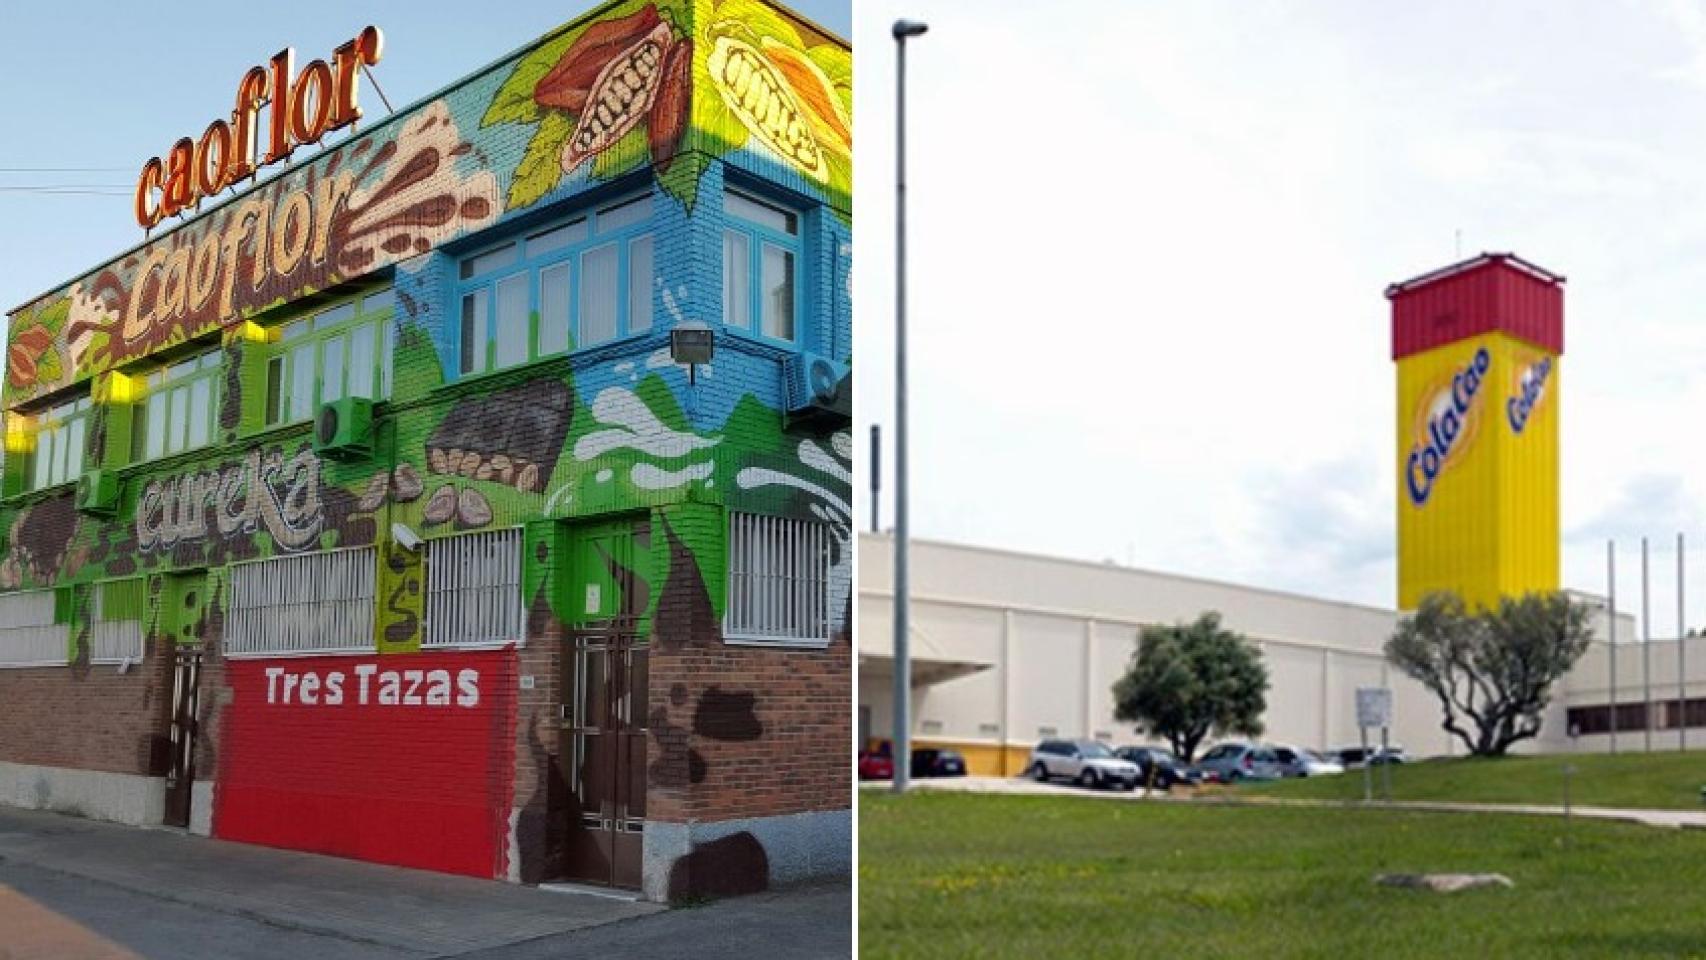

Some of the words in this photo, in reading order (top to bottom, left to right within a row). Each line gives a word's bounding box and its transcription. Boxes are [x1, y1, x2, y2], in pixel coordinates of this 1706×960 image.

[134, 25, 384, 229] caoflor
[1406, 347, 1489, 507] ColaCao
[265, 667, 345, 704] Tres
[354, 663, 480, 707] Tazas
